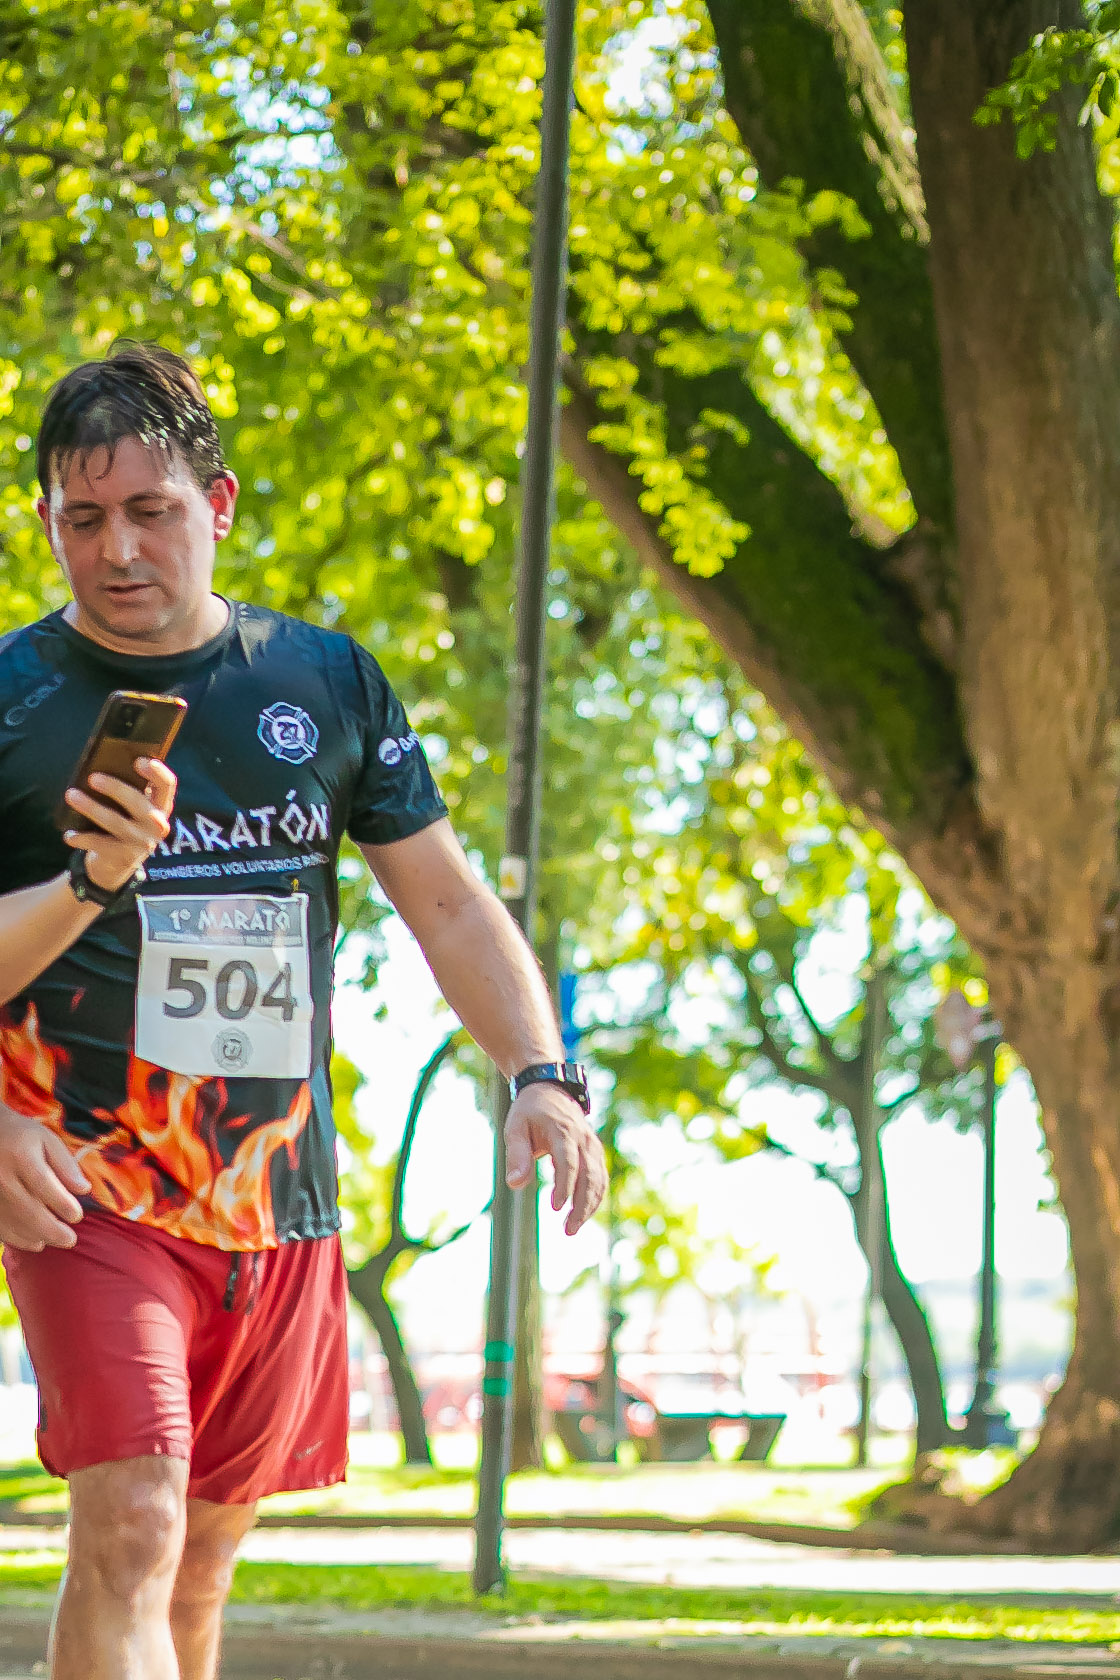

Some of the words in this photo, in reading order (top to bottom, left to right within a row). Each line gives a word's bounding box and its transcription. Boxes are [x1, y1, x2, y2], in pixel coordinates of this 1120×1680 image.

[149, 788, 329, 858] ARATÓN
[148, 863, 222, 881] BOMBEROS
[162, 956, 298, 1023] 504
